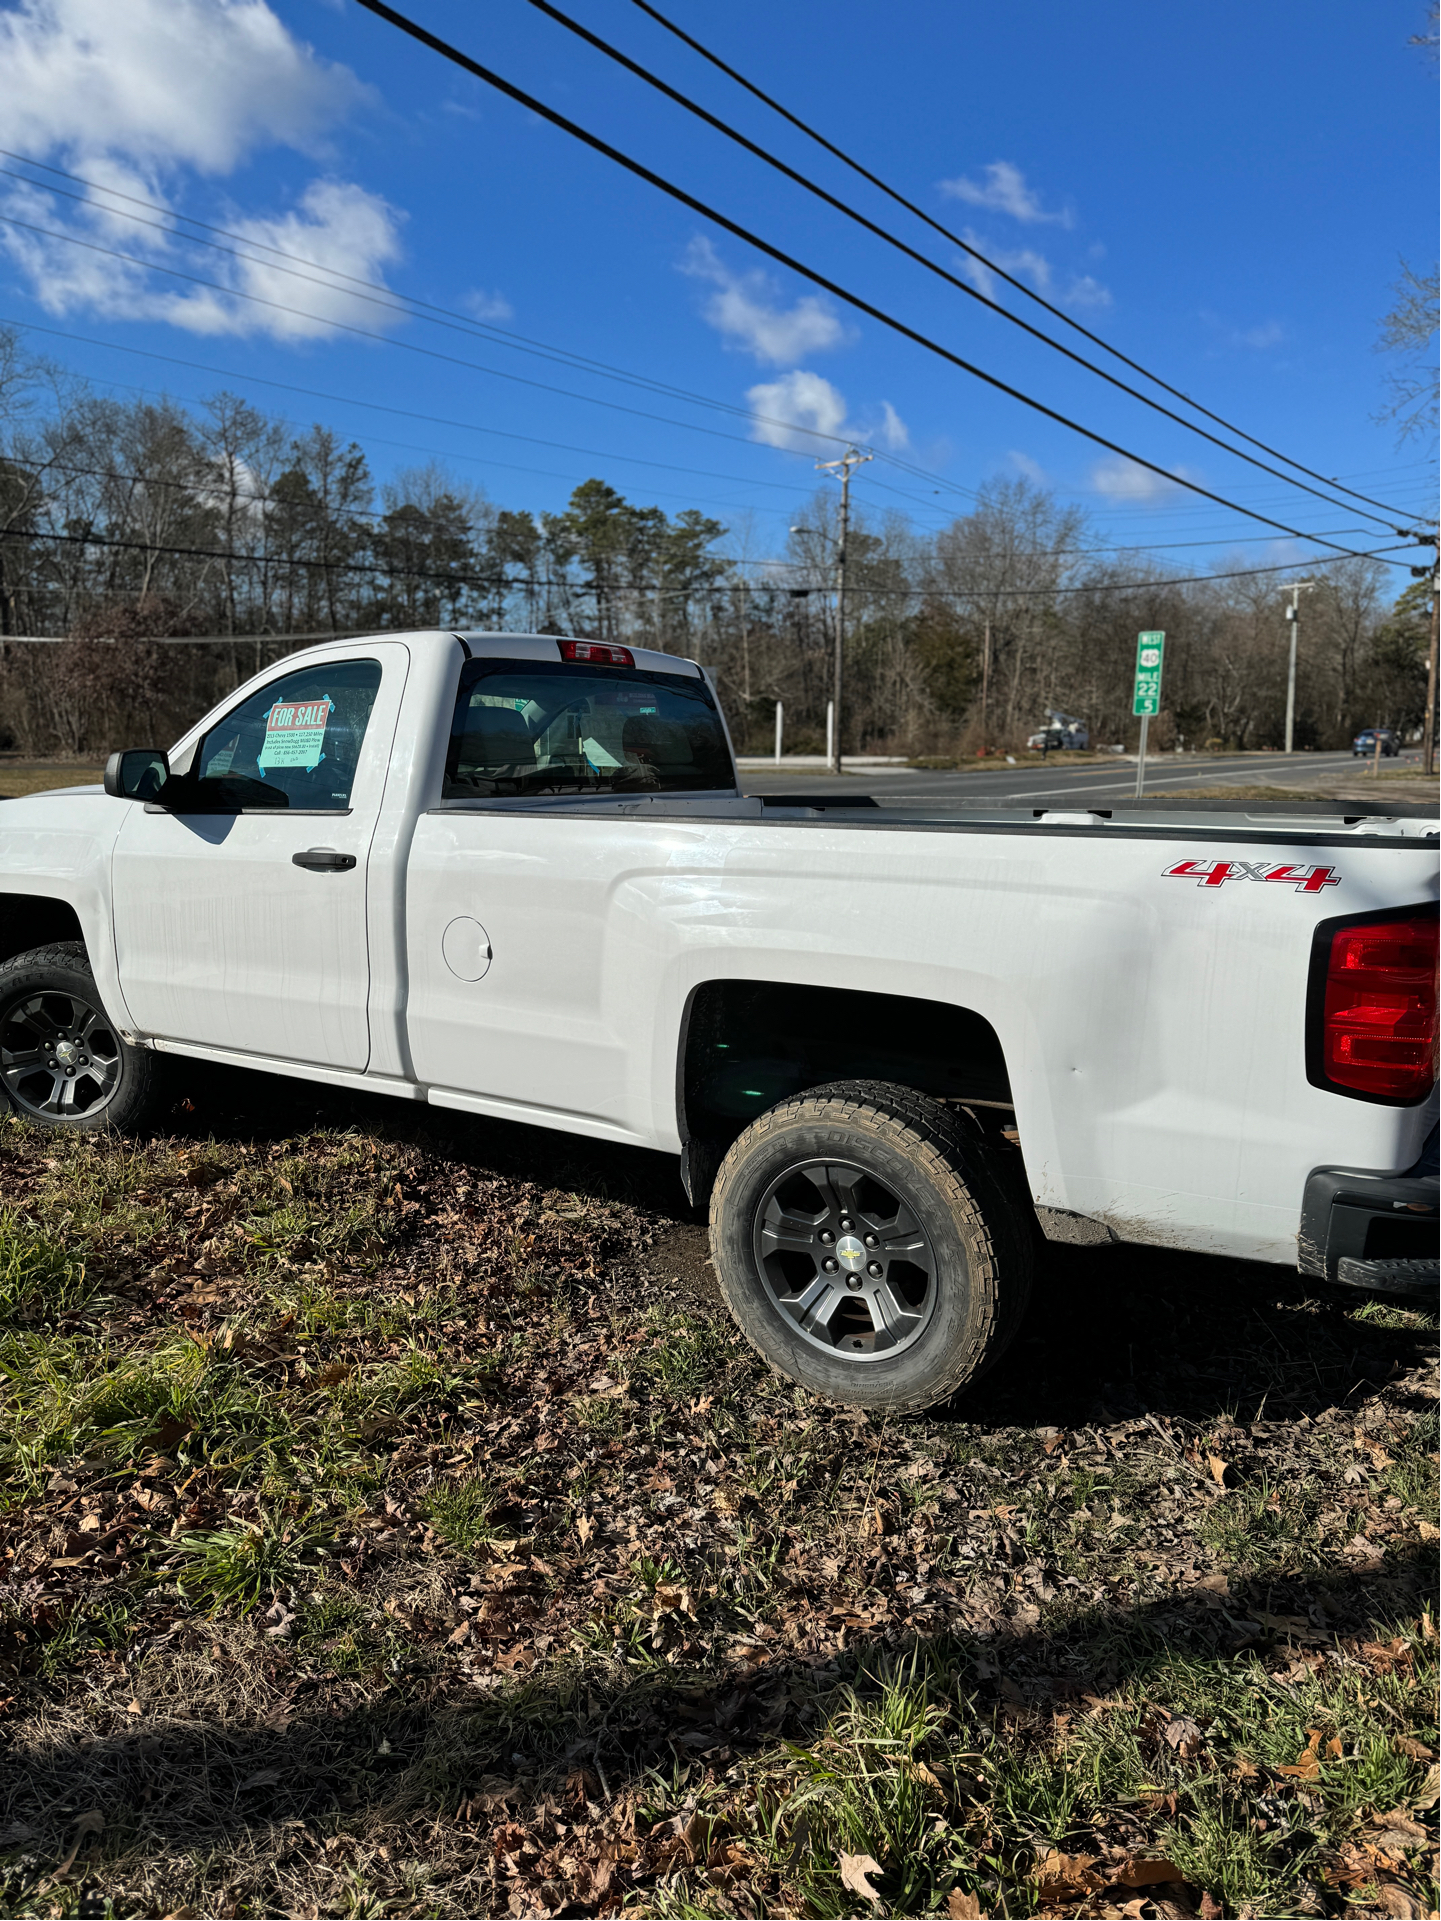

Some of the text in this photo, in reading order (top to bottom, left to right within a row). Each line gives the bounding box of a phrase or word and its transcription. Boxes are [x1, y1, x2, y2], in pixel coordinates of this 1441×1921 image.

[1142, 634, 1161, 645] WEST
[1142, 653, 1158, 664] 40
[1138, 671, 1159, 682] MILE
[1138, 682, 1158, 696] 22
[271, 704, 326, 727] FOR SALE
